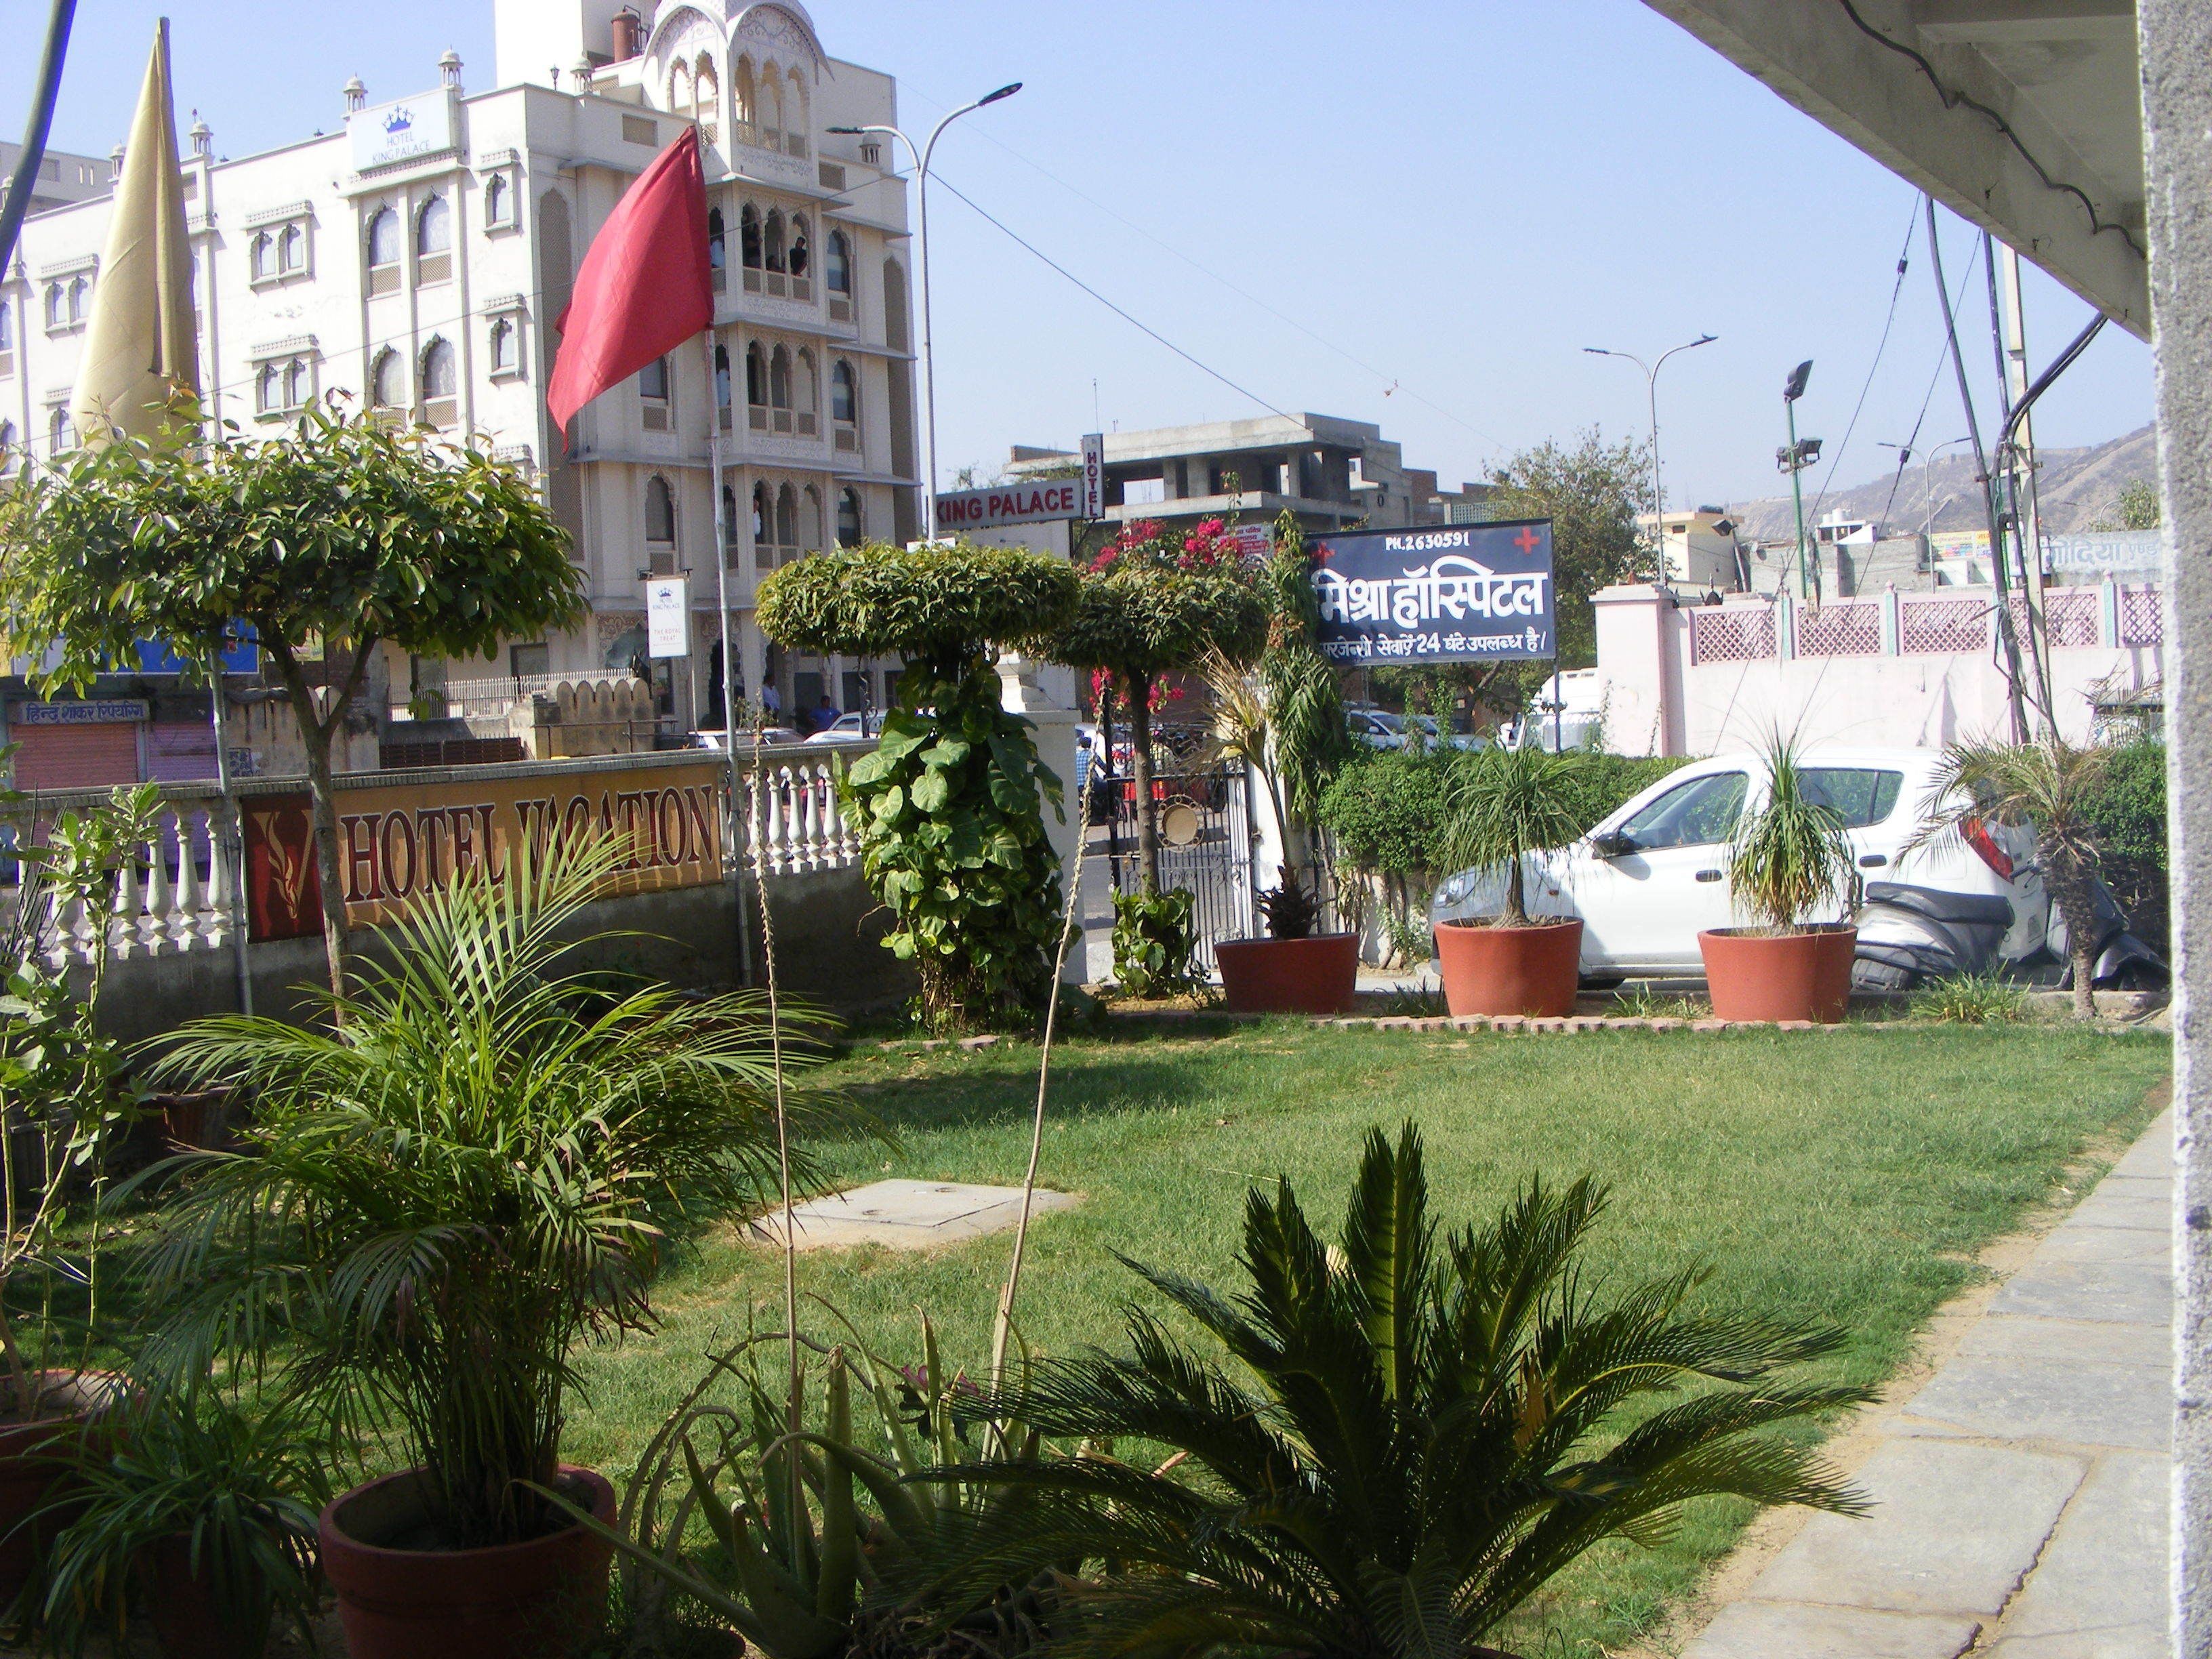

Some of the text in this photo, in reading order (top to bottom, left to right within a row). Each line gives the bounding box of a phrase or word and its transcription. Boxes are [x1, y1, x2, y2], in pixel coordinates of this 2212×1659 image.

[373, 140, 430, 164] KING PALACE
[387, 131, 413, 147] HOTEL
[1086, 451, 1099, 517] HOTEL
[989, 487, 1075, 517] PALACE
[1311, 554, 1549, 629] मिश्रा हॉस्पिटल
[1416, 632, 1441, 653] 24
[1443, 631, 1467, 652] घंटे
[1467, 634, 1523, 653] उपलब्ध
[340, 785, 713, 905] HOTEL VACATION
